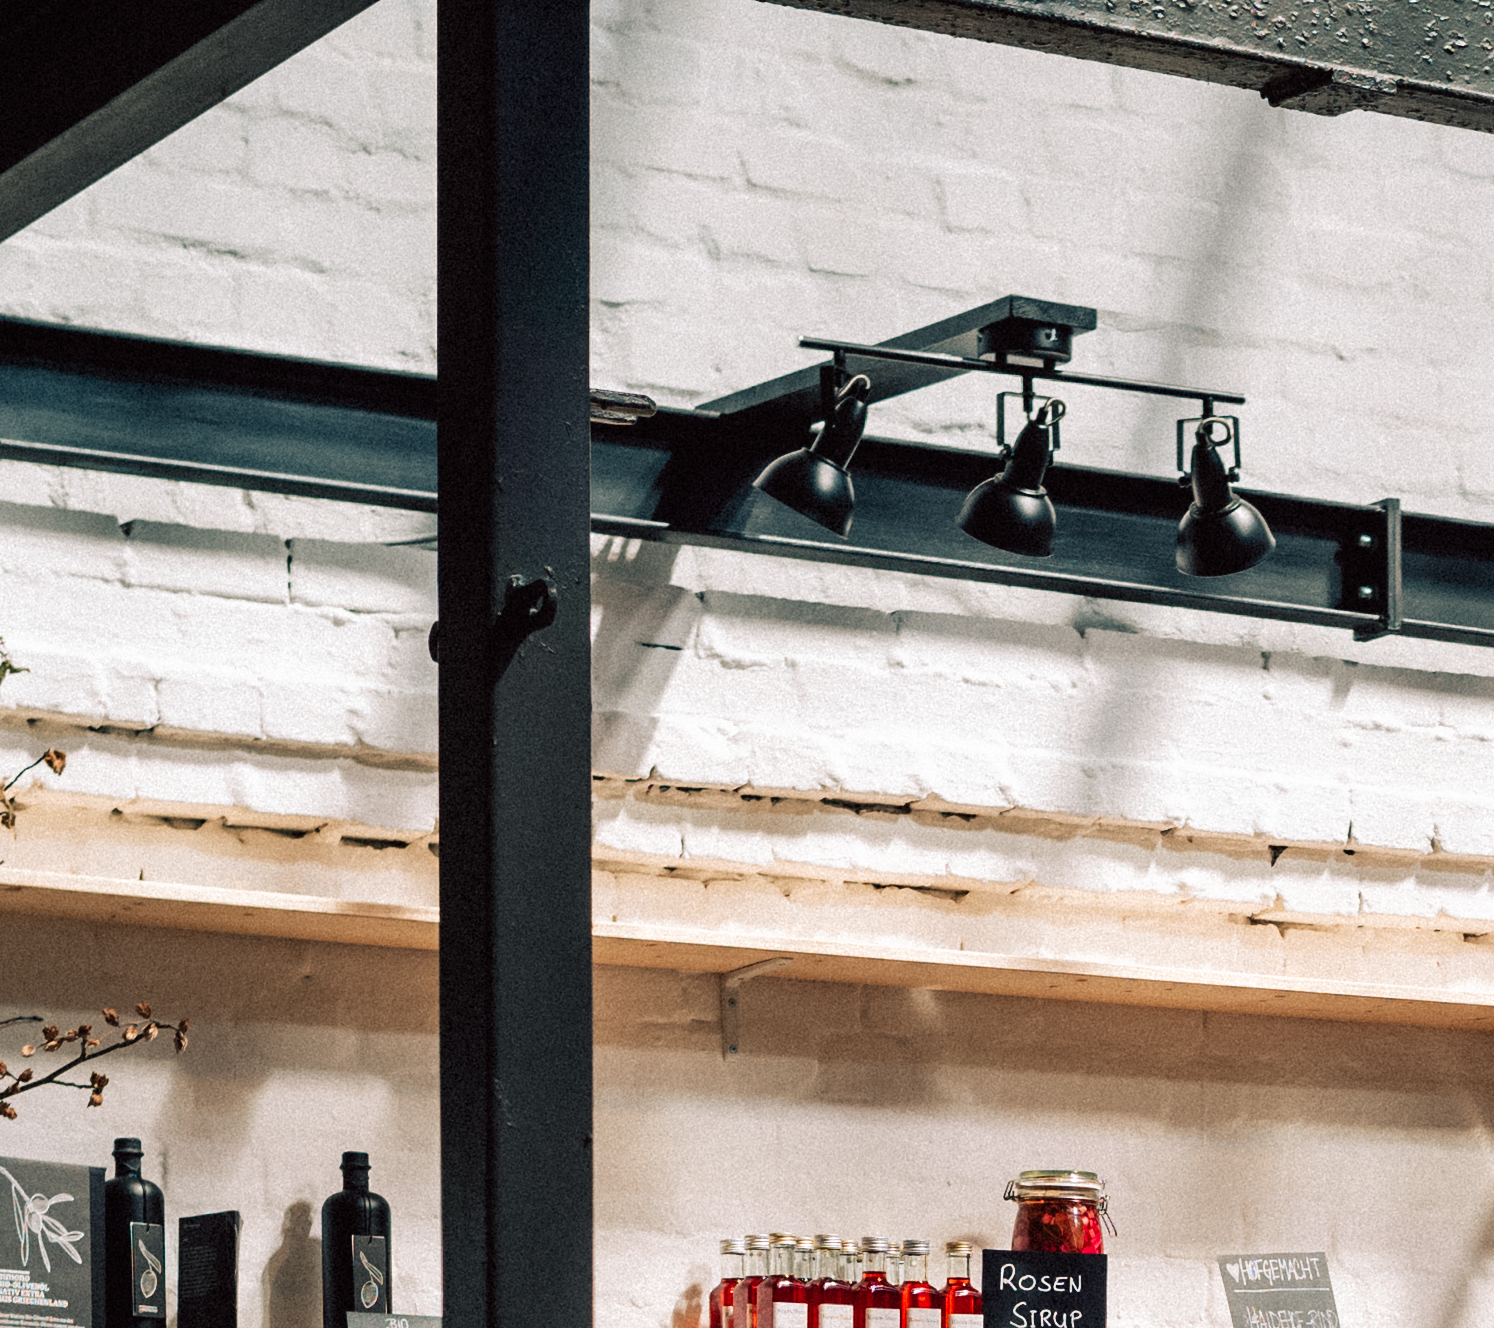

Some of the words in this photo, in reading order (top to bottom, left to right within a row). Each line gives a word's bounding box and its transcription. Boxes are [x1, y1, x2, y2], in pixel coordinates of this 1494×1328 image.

[1000, 1263, 1082, 1293] ROSEN
[1239, 1257, 1319, 1286] HOFGEMACHT
[1010, 1302, 1082, 1328] SIRUP
